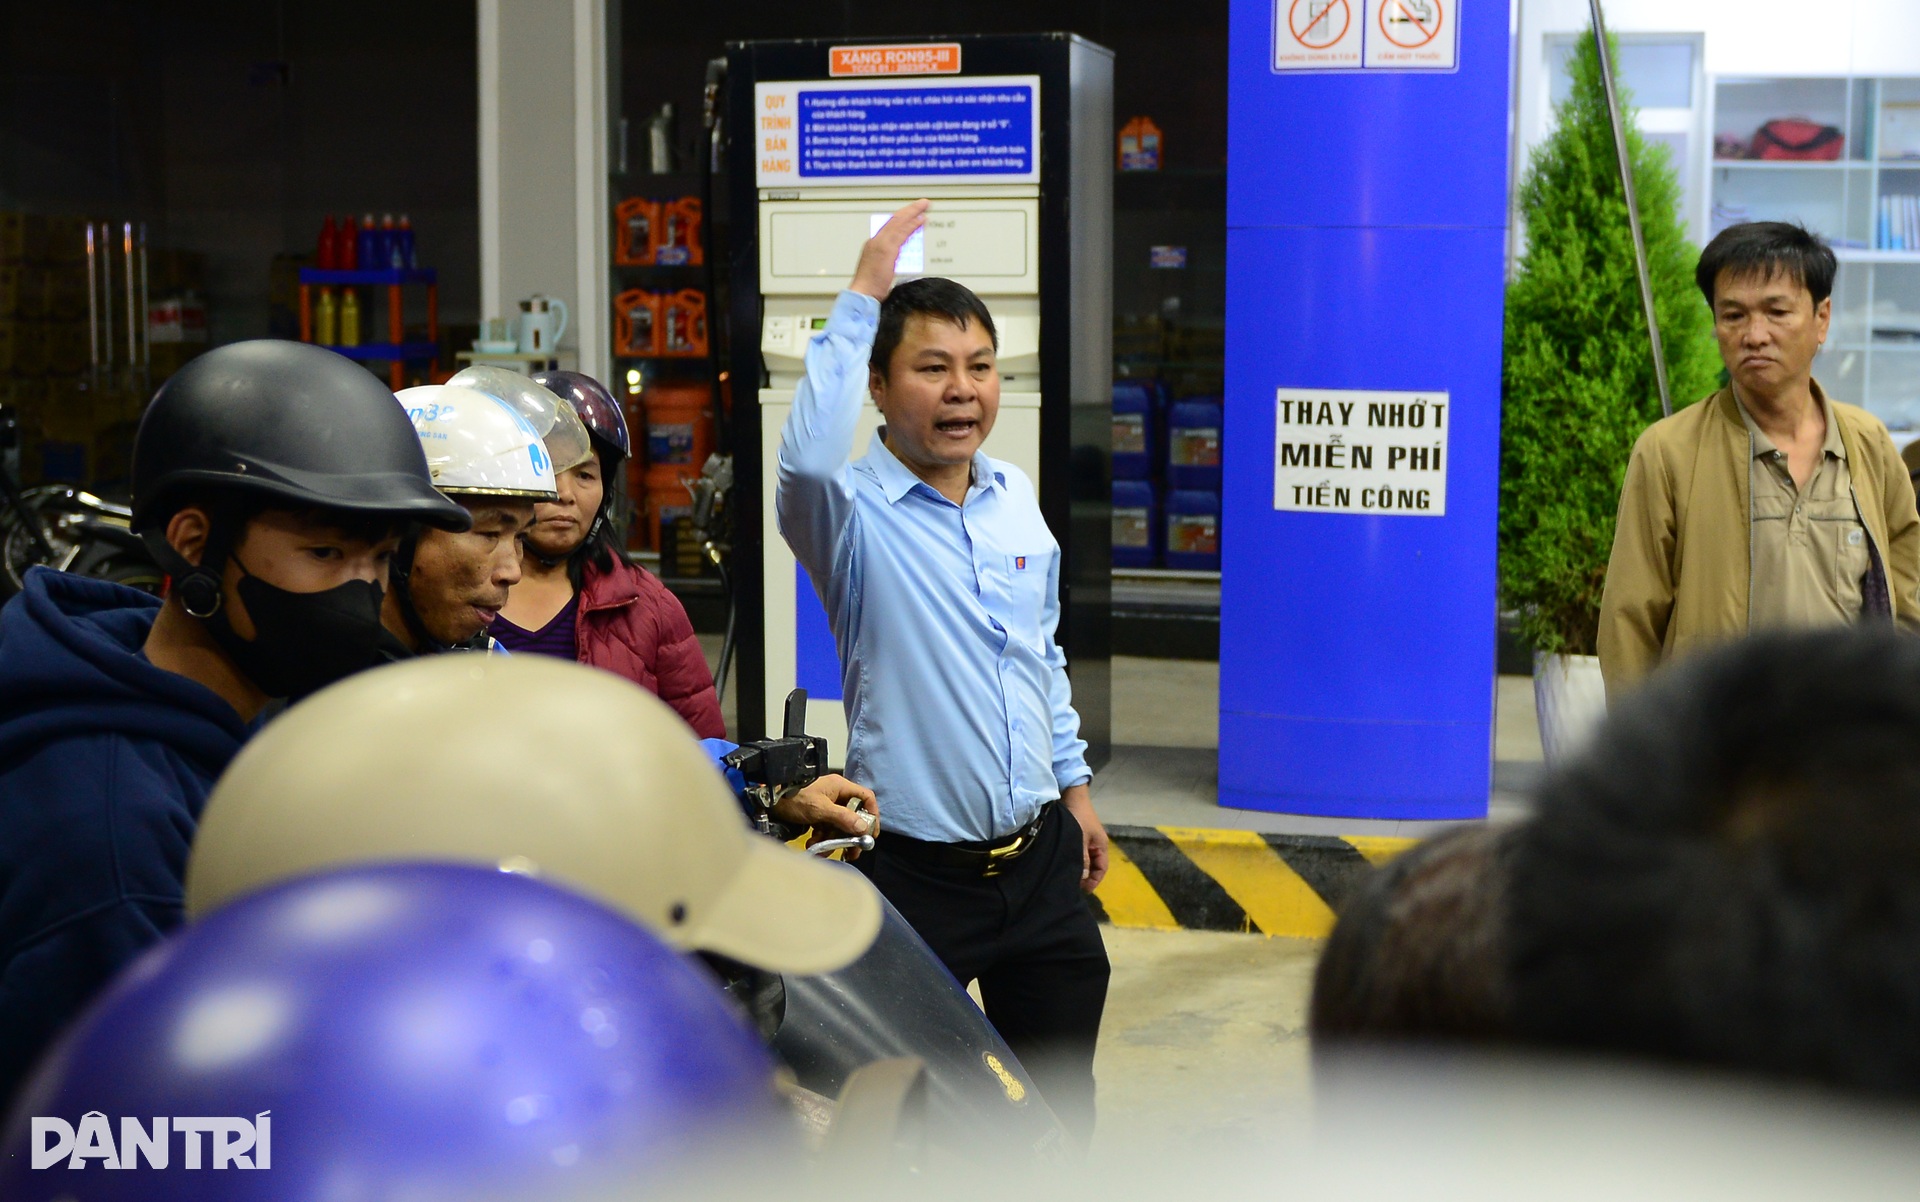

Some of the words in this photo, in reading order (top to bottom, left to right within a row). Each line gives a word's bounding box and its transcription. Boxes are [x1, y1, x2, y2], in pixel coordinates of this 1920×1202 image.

[841, 50, 882, 65] XĂNG
[885, 50, 949, 63] RON95-III
[765, 95, 785, 110] QUY
[761, 113, 791, 130] TRÌNH
[765, 135, 787, 151] BÁN
[762, 156, 791, 172] HÀNG
[1280, 400, 1354, 426] THAY
[1368, 398, 1445, 428] NHỚT
[1281, 434, 1372, 469] MIỄN
[1388, 440, 1441, 471] PHÍ
[1292, 480, 1350, 507] TIỀN
[1361, 484, 1430, 509] CÔNG
